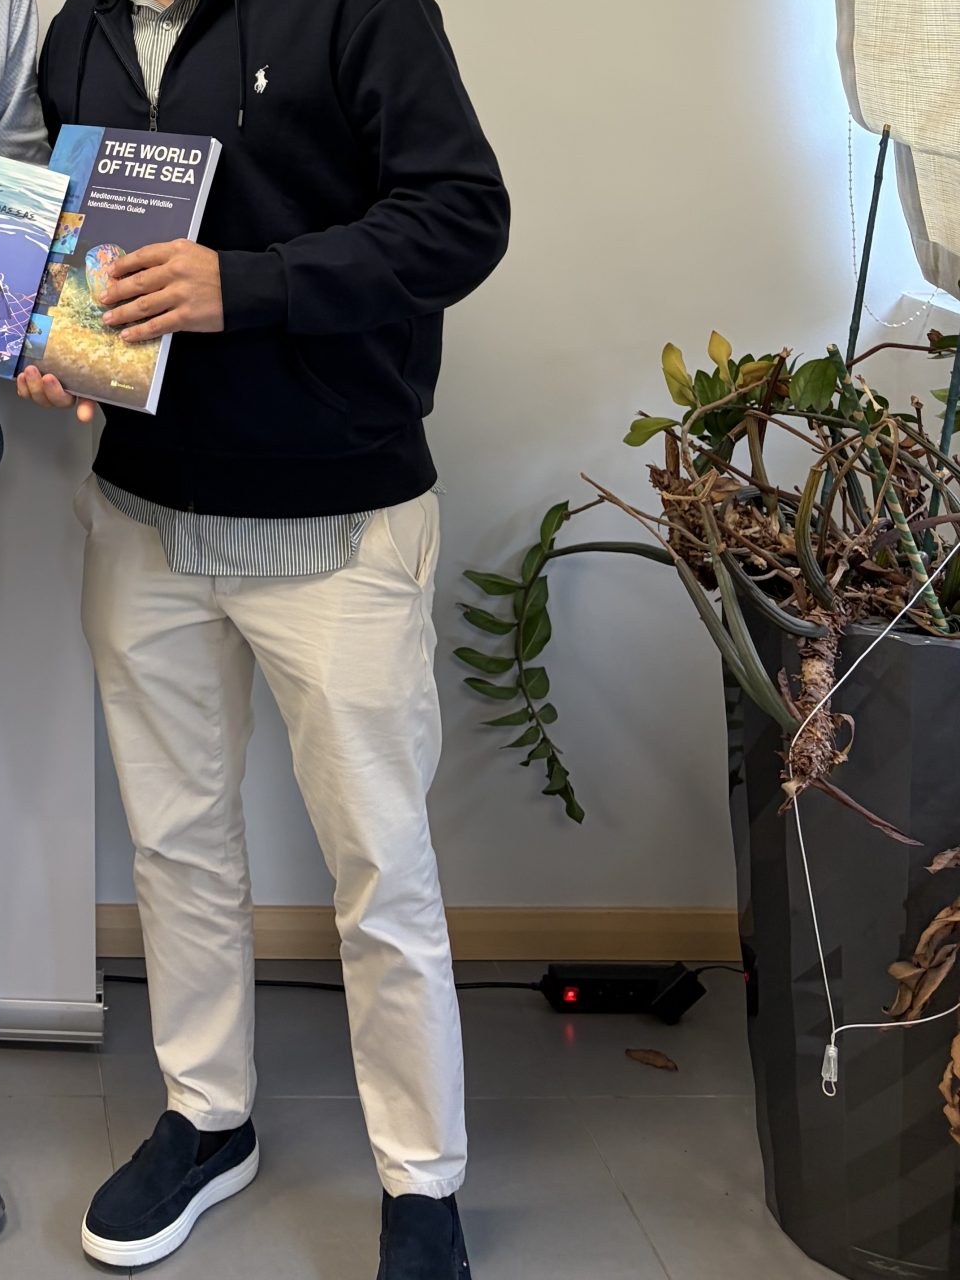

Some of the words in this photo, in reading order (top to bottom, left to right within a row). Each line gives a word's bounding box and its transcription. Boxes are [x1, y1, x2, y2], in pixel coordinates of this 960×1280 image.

[105, 140, 137, 158] THE
[140, 144, 202, 165] WORLD
[97, 159, 122, 175] OF
[124, 161, 158, 180] THE
[160, 166, 195, 185] SEA
[87, 200, 126, 211] Identification
[126, 204, 146, 215] Guide
[127, 196, 149, 206] Marine
[150, 199, 174, 209] Wildlife
